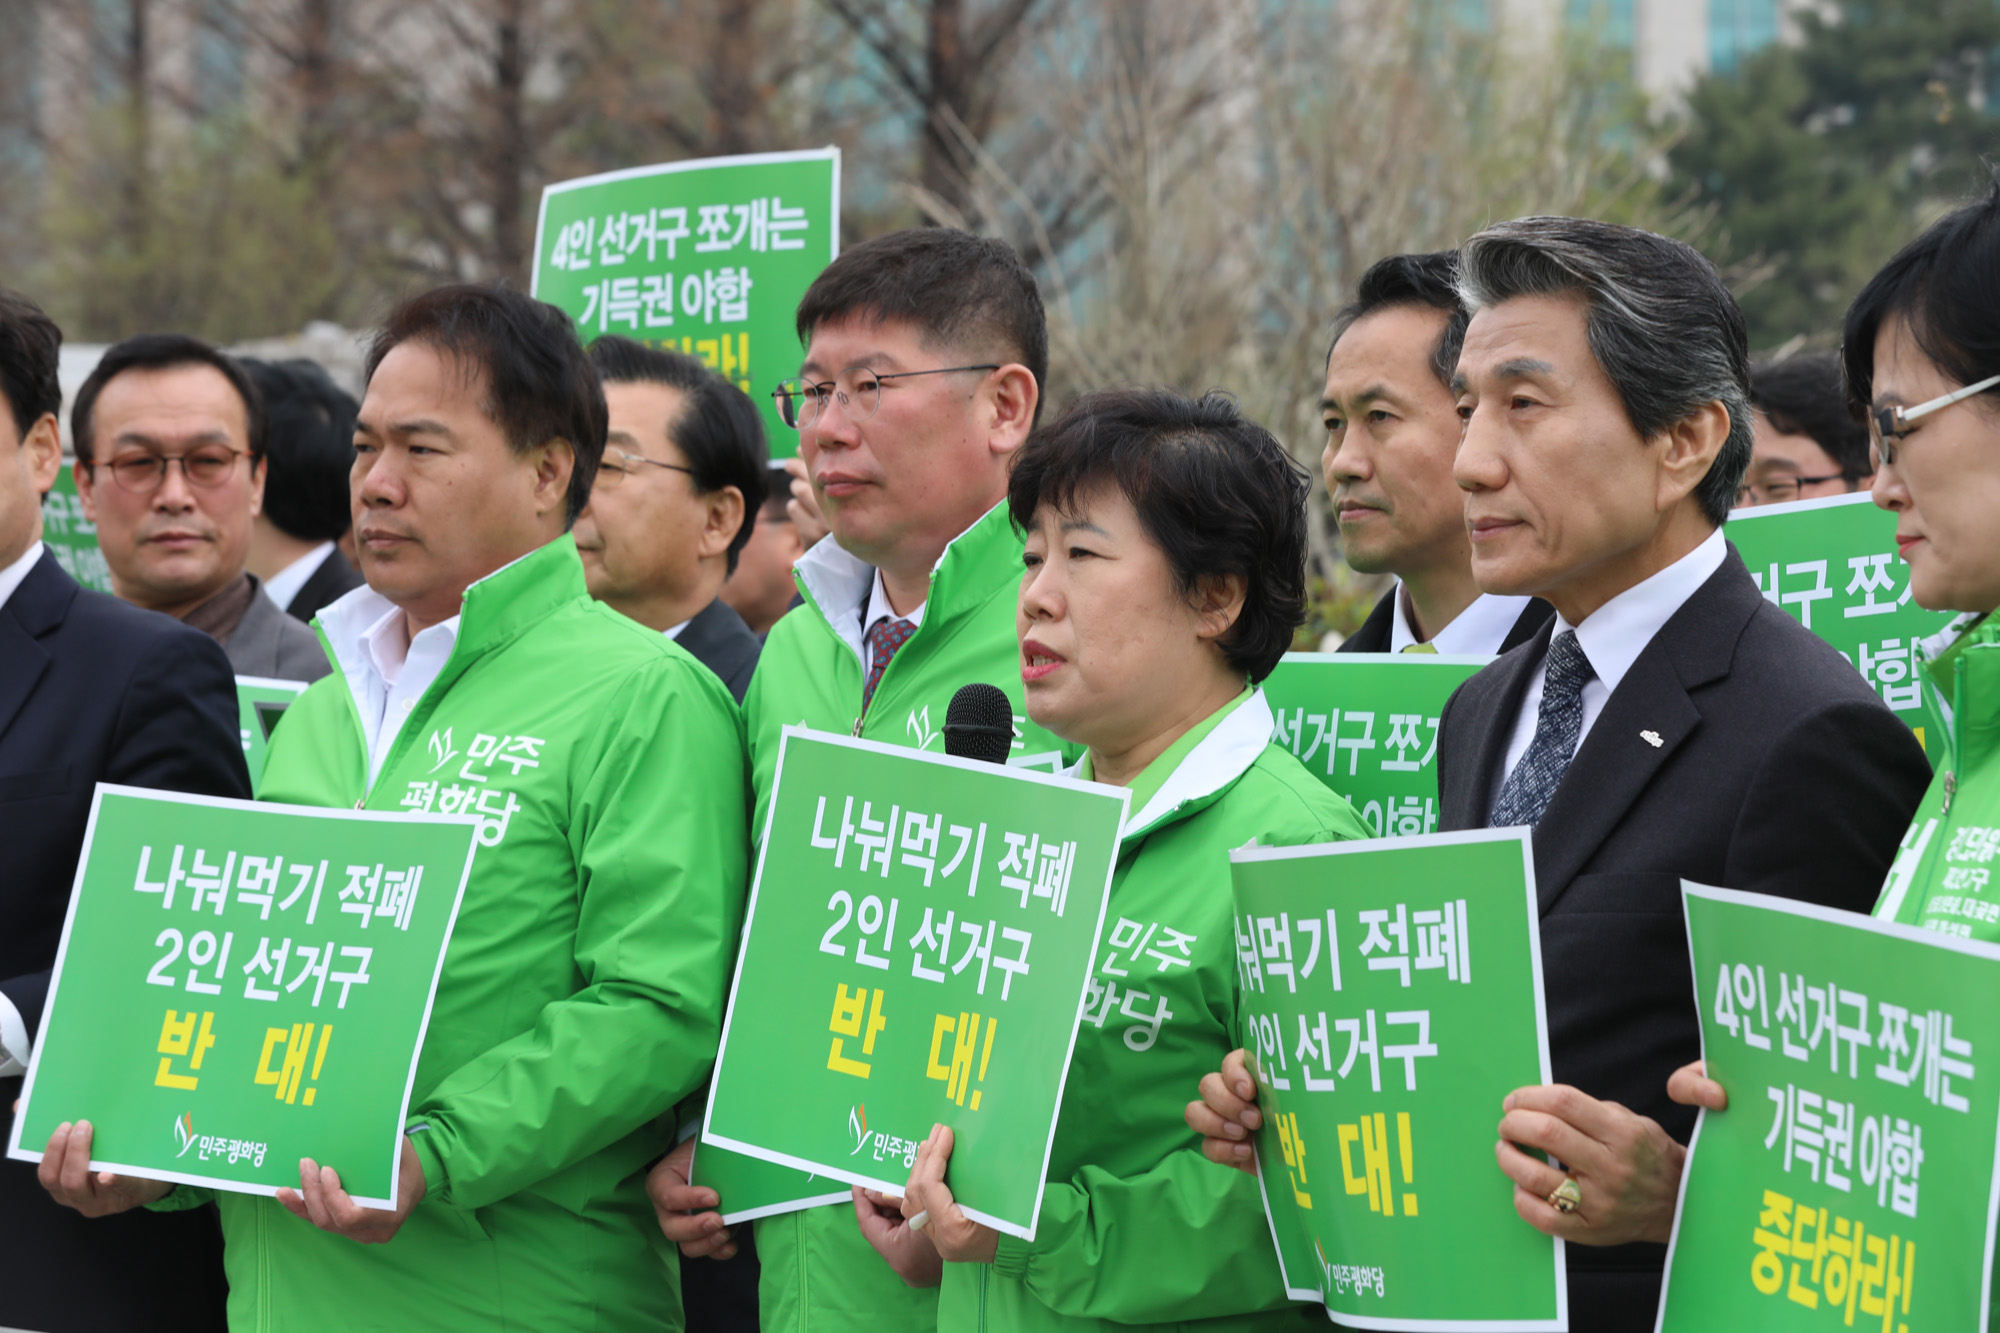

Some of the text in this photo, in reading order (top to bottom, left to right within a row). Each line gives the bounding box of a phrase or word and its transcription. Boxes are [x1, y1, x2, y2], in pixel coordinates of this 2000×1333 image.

[550, 197, 809, 271] 4인 선거구 쪼개는
[579, 266, 752, 332] 기득권 야합
[459, 732, 546, 783] 민주
[133, 844, 424, 931] 나눠먹기 적폐
[810, 795, 1077, 918] 나눠먹기 적폐
[146, 928, 373, 1009] 2인 선거구
[819, 889, 1033, 1002] 2인 선거구
[1101, 916, 1198, 978] 민주
[1358, 899, 1471, 988] 적폐
[826, 982, 998, 1112] 반 대!
[1081, 977, 1174, 1052] 화당
[1249, 1009, 1438, 1092] 2인 선거구
[1714, 962, 1975, 1113] 4인 선거구 쪼개는
[154, 1009, 333, 1106] 반 대!
[198, 1135, 268, 1168] 민주평화당
[873, 1132, 919, 1168] 민주평
[1337, 1111, 1419, 1217] 대!
[1764, 1083, 1924, 1219] 기득권 야합
[1332, 1262, 1385, 1298] 민주평화당
[1751, 1188, 1916, 1333] 중단하라!
